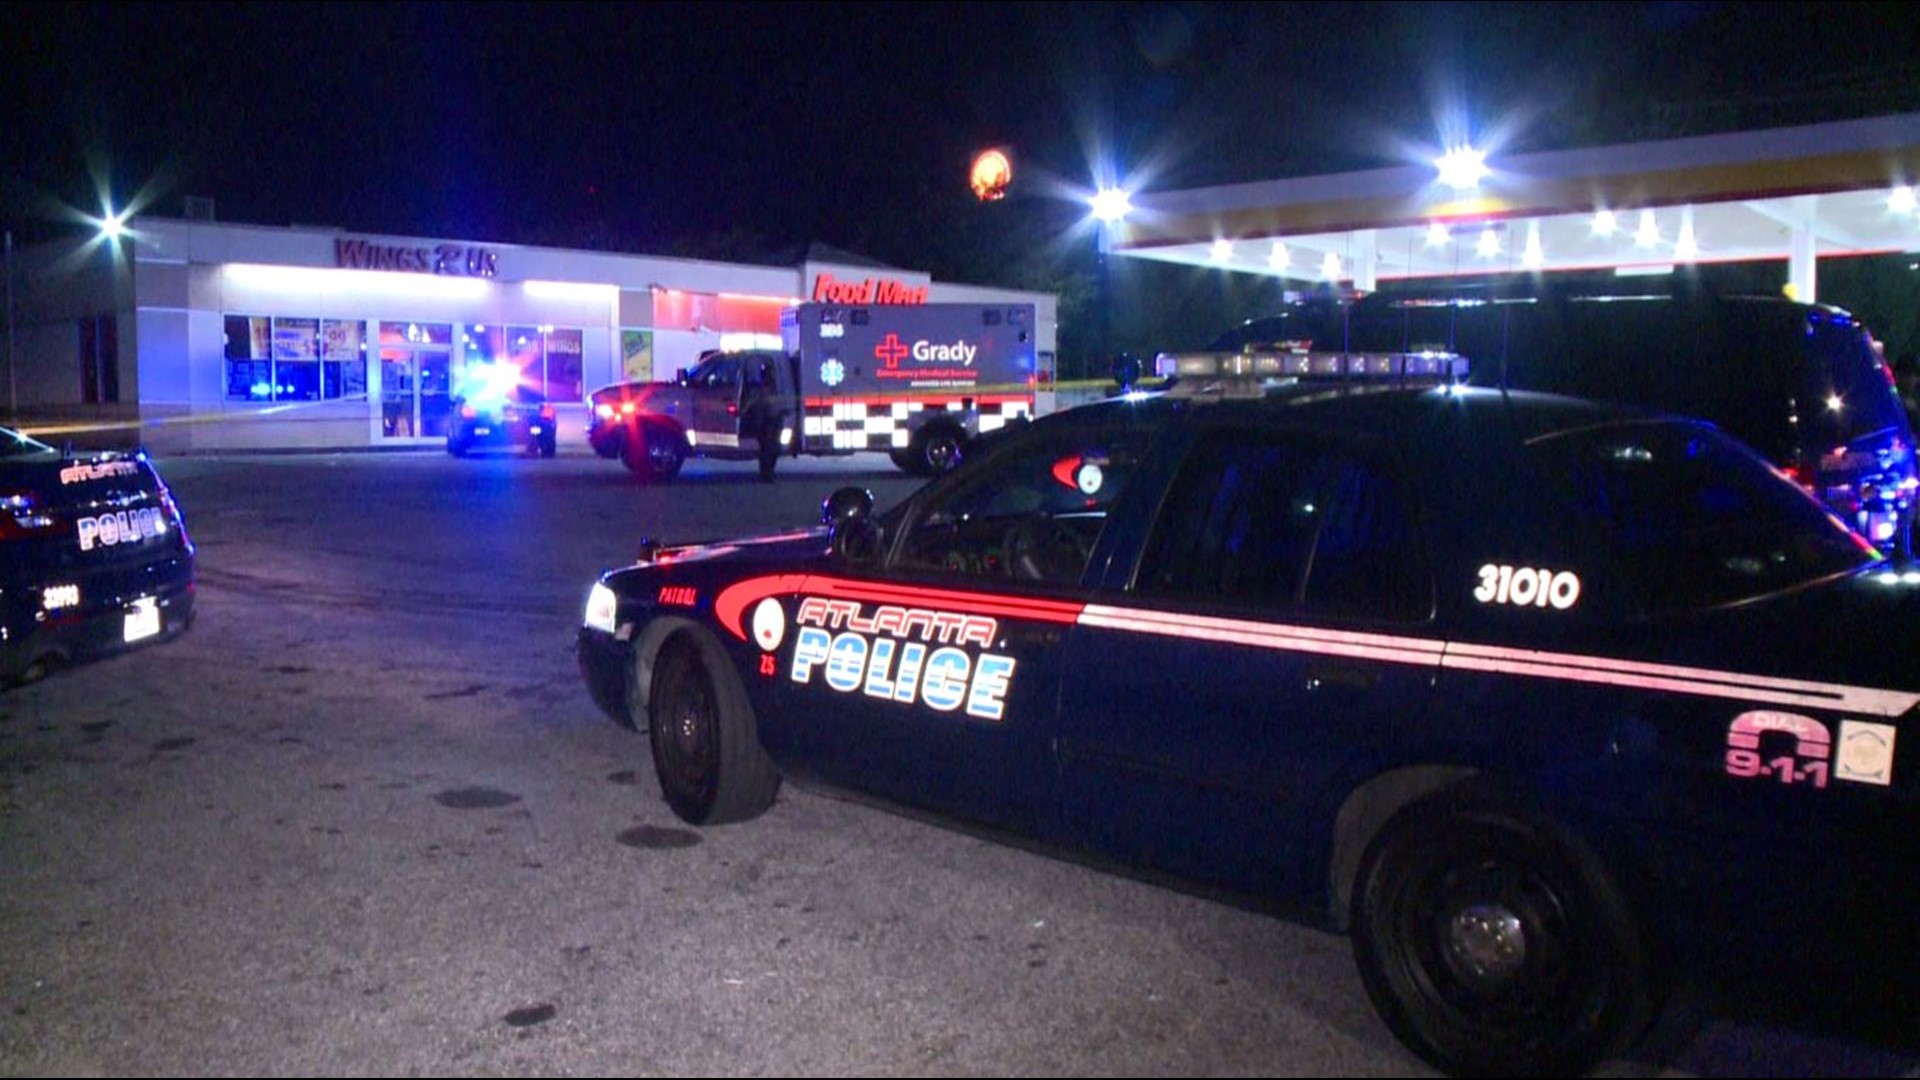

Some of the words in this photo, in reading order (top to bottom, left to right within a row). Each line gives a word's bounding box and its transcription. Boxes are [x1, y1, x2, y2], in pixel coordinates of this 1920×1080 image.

[813, 272, 875, 305] Food
[912, 340, 977, 366] Grady
[659, 586, 696, 606] PATROL
[1473, 563, 1581, 610] 31010
[796, 597, 997, 648] ATLANTA
[791, 625, 1016, 721] POLICE
